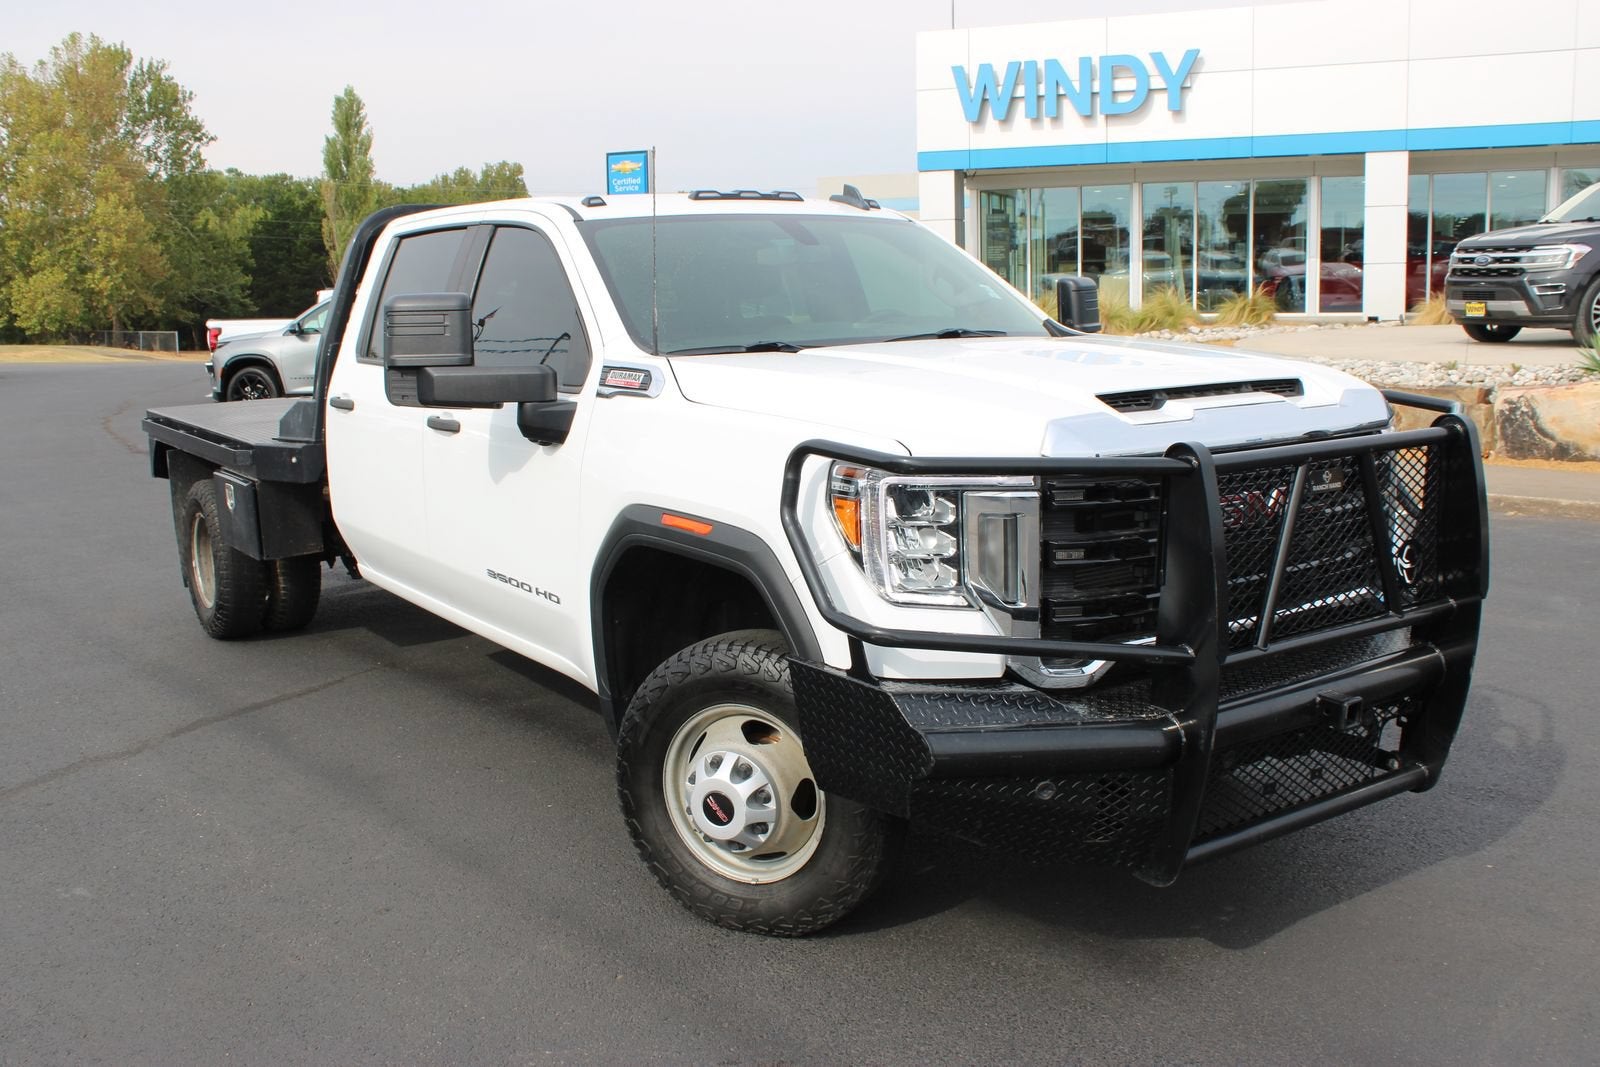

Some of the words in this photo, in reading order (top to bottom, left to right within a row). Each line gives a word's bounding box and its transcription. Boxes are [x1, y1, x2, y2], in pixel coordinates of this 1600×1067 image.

[951, 49, 1200, 122] WINDY
[612, 177, 641, 186] Certified
[610, 371, 642, 382] DURAMAX
[1329, 481, 1342, 489] HAND
[486, 568, 533, 593] 3500
[535, 587, 561, 605] HD
[706, 795, 729, 822] GMC
